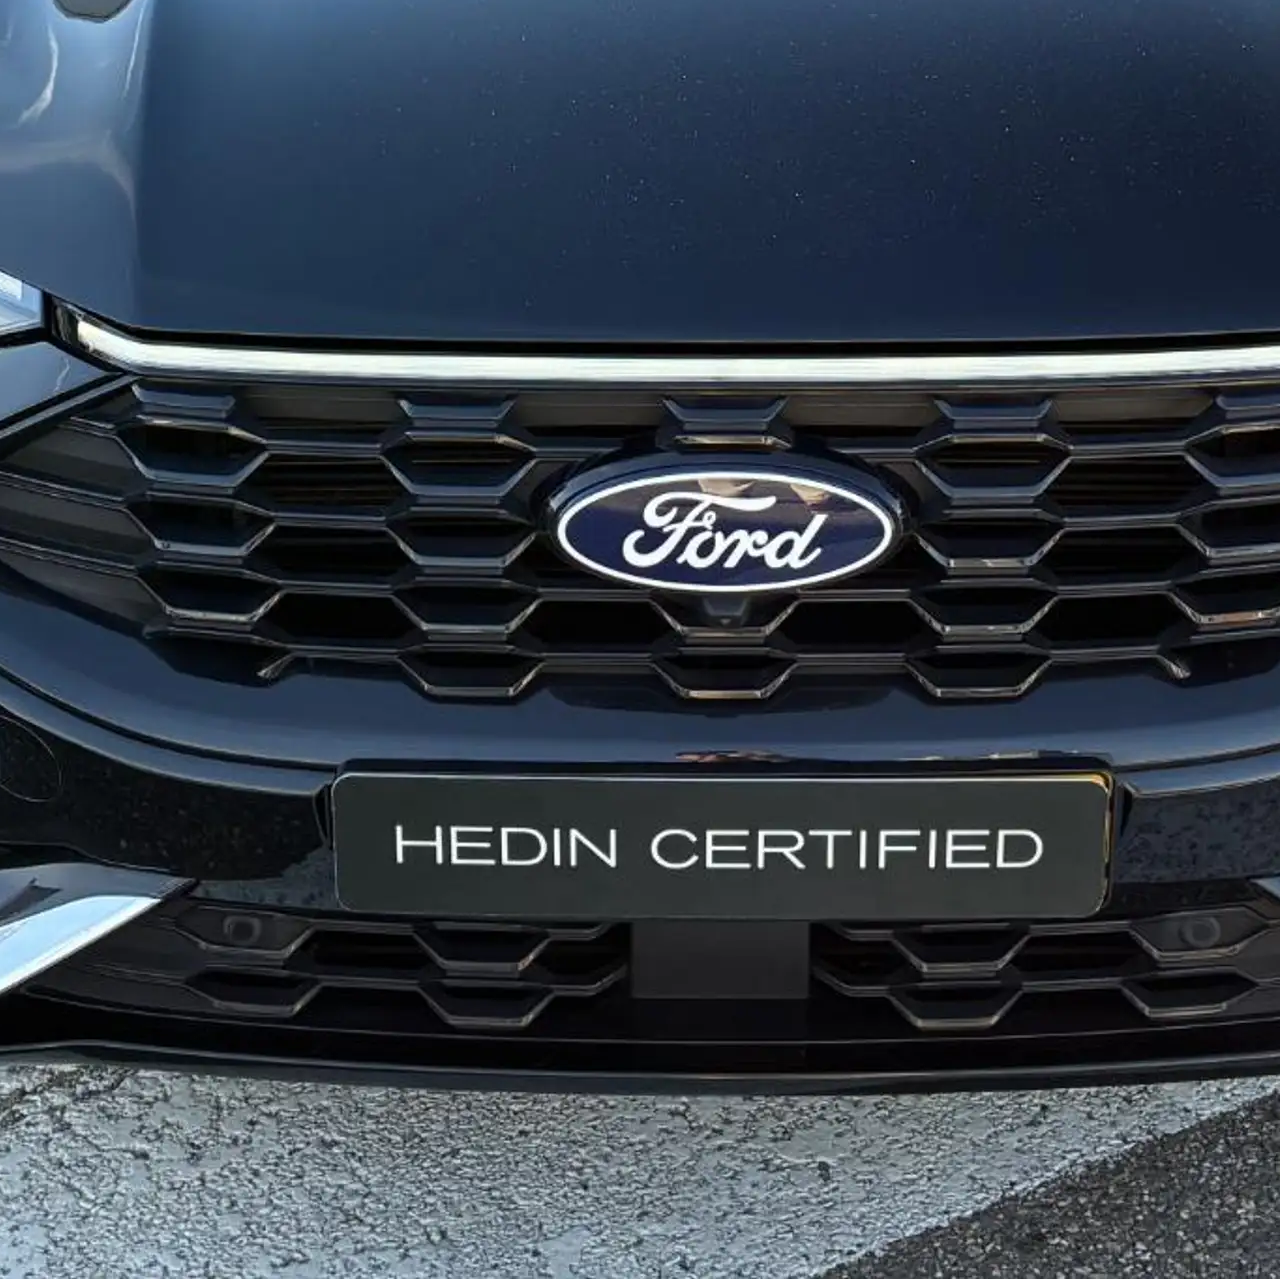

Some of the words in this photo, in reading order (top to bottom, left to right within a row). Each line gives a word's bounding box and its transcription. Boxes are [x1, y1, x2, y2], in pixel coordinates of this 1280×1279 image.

[622, 491, 829, 570] Ford
[394, 824, 618, 868] HEDIN
[649, 828, 1044, 870] CERTIFIED
